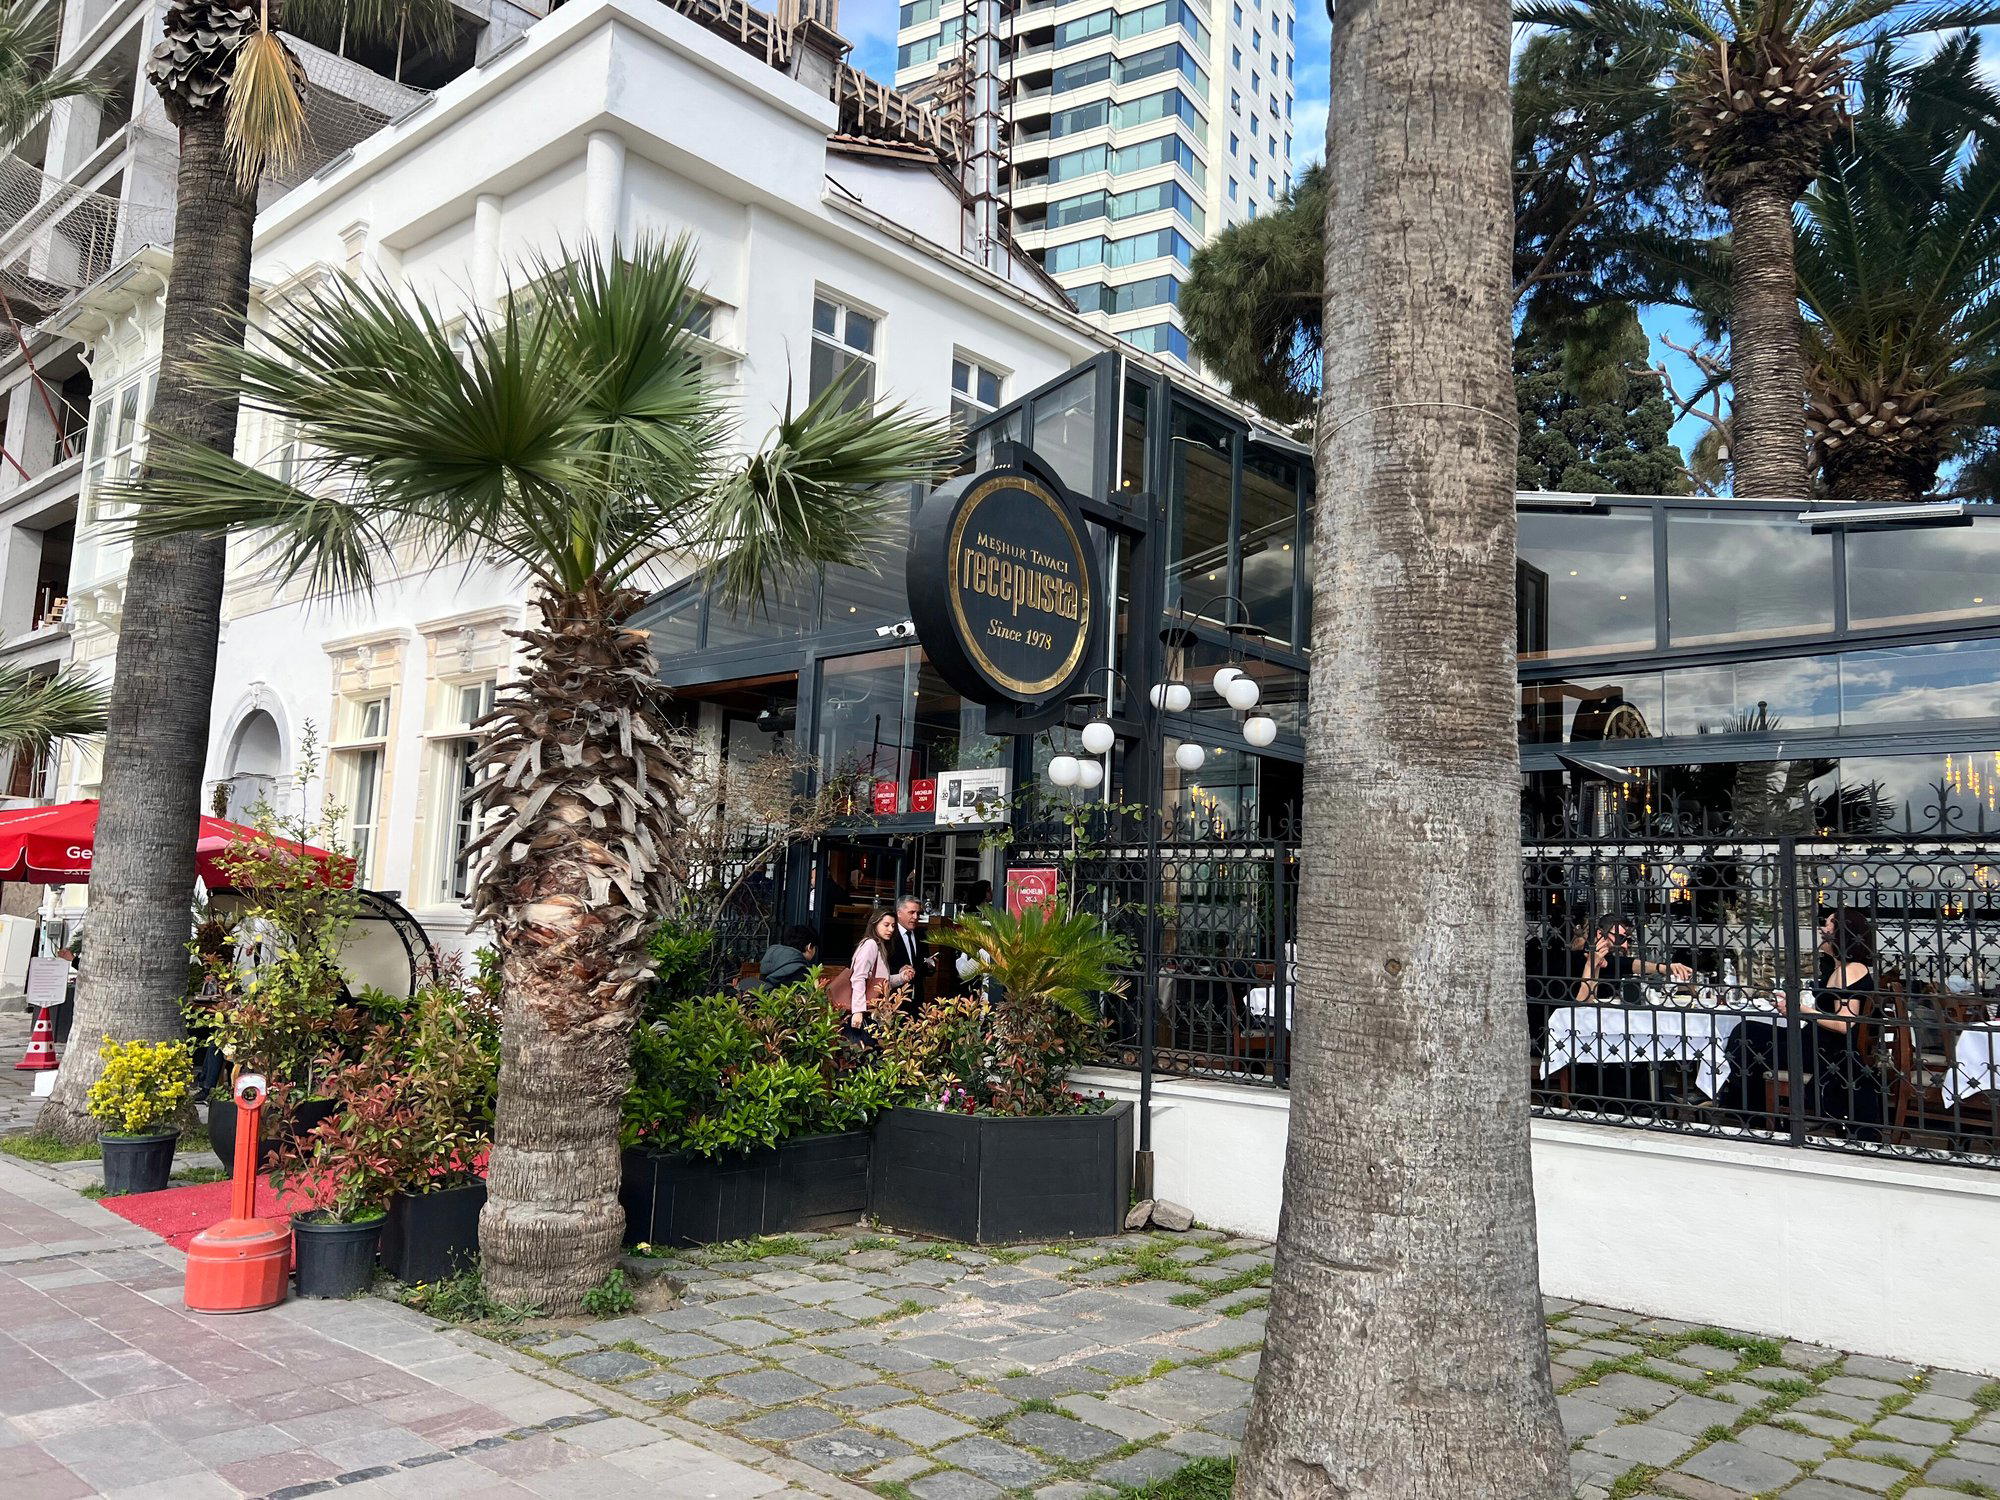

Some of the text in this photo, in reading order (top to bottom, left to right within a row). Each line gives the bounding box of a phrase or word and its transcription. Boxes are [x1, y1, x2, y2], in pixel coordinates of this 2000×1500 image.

[977, 532, 1069, 574] MEŞHUR TAVACI
[963, 547, 1078, 621] recepusta
[987, 618, 1052, 650] Since 1978
